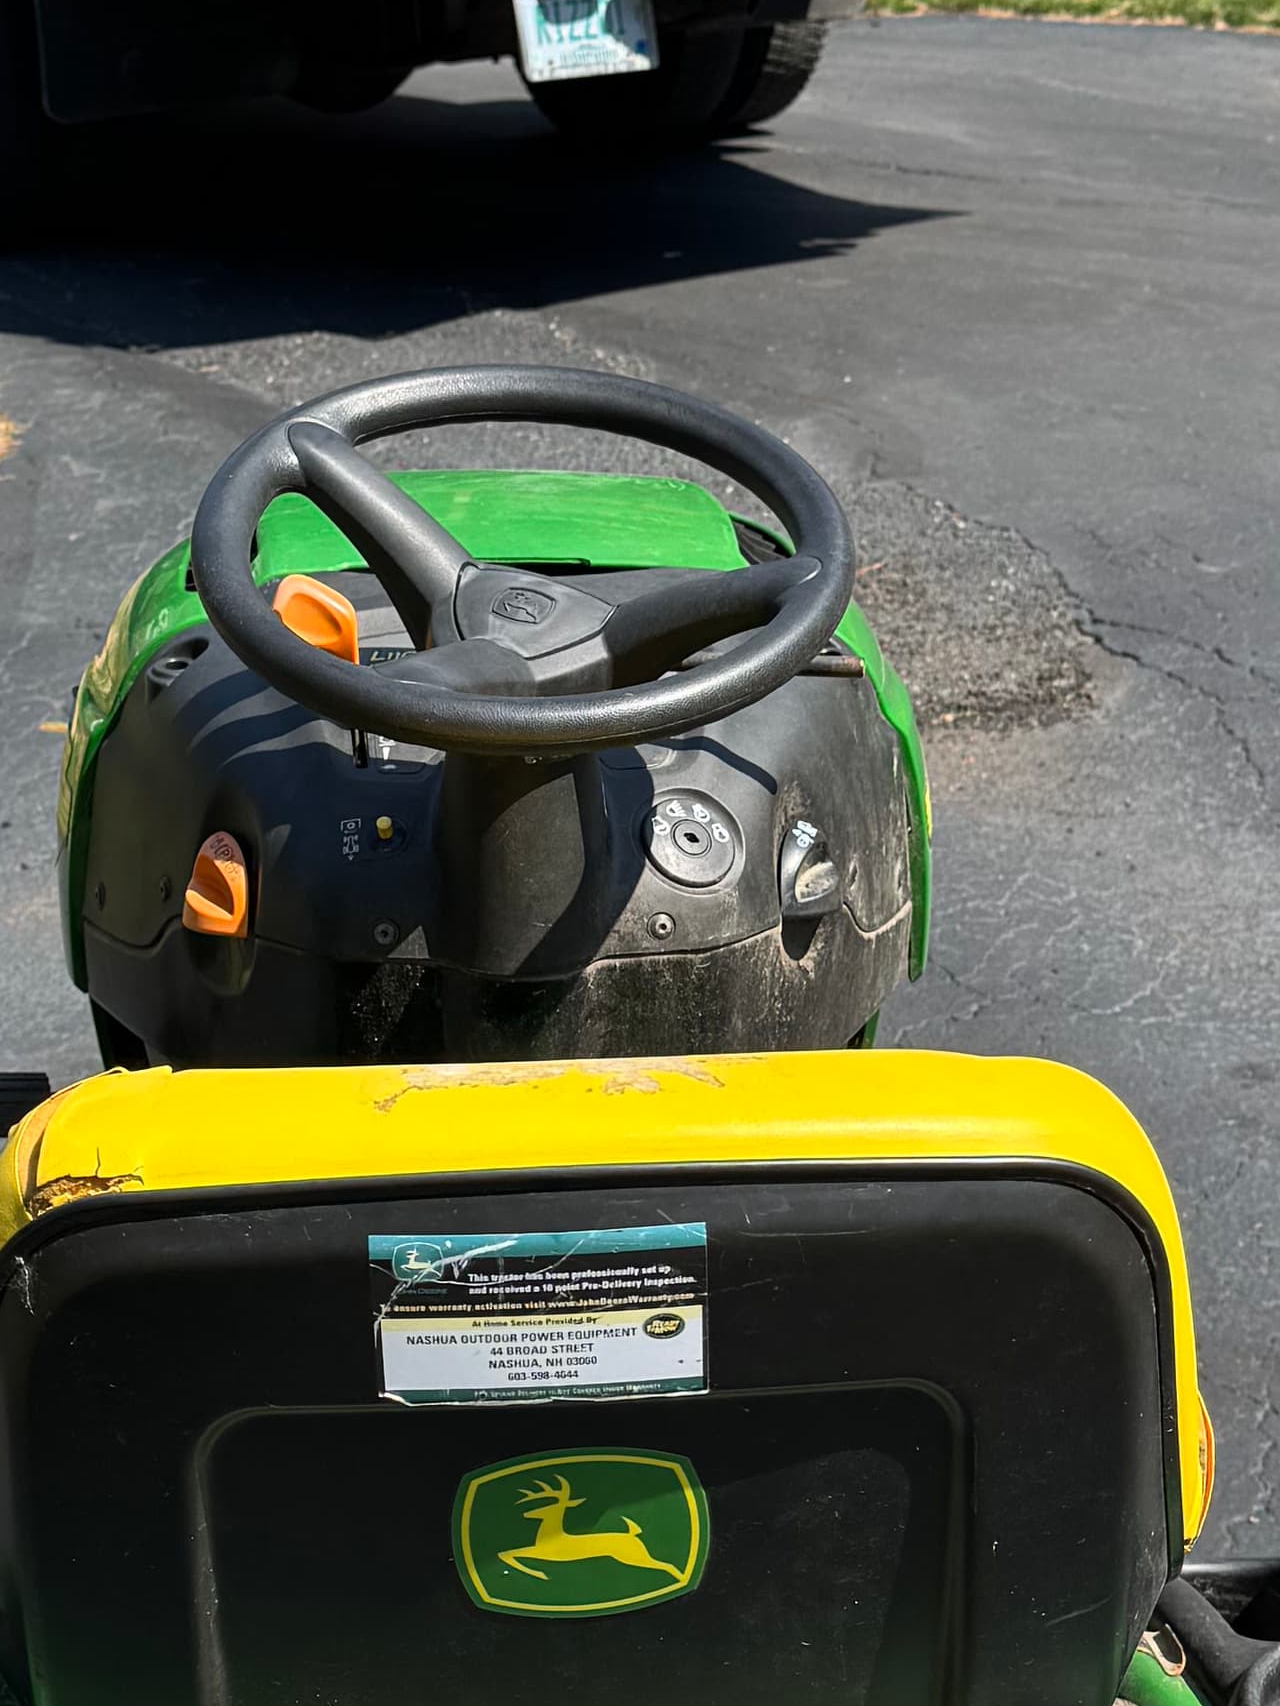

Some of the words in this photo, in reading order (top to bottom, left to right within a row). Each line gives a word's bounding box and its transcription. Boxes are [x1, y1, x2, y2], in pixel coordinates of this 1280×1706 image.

[467, 1273, 489, 1282] This
[545, 1271, 570, 1280] been
[571, 1266, 639, 1281] professionally
[642, 1265, 657, 1274] set
[469, 1286, 487, 1294] and
[489, 1285, 531, 1294] received
[581, 1280, 642, 1291] Pre-Delivery
[393, 1305, 426, 1313] ensure
[428, 1304, 472, 1312] warranty
[474, 1301, 522, 1311] activation
[524, 1300, 546, 1309] visit
[484, 1319, 508, 1327] Home
[545, 1316, 584, 1326] Provided
[406, 1335, 458, 1345] NASHUA
[460, 1333, 518, 1344] OUTDOOR
[521, 1331, 564, 1342] POWER
[567, 1327, 637, 1341] EQUIPMENT
[490, 1347, 503, 1355] 44
[506, 1345, 548, 1355] BROAD
[551, 1342, 595, 1354] STREET
[488, 1359, 542, 1369] NASHUA,
[545, 1357, 563, 1367] NH
